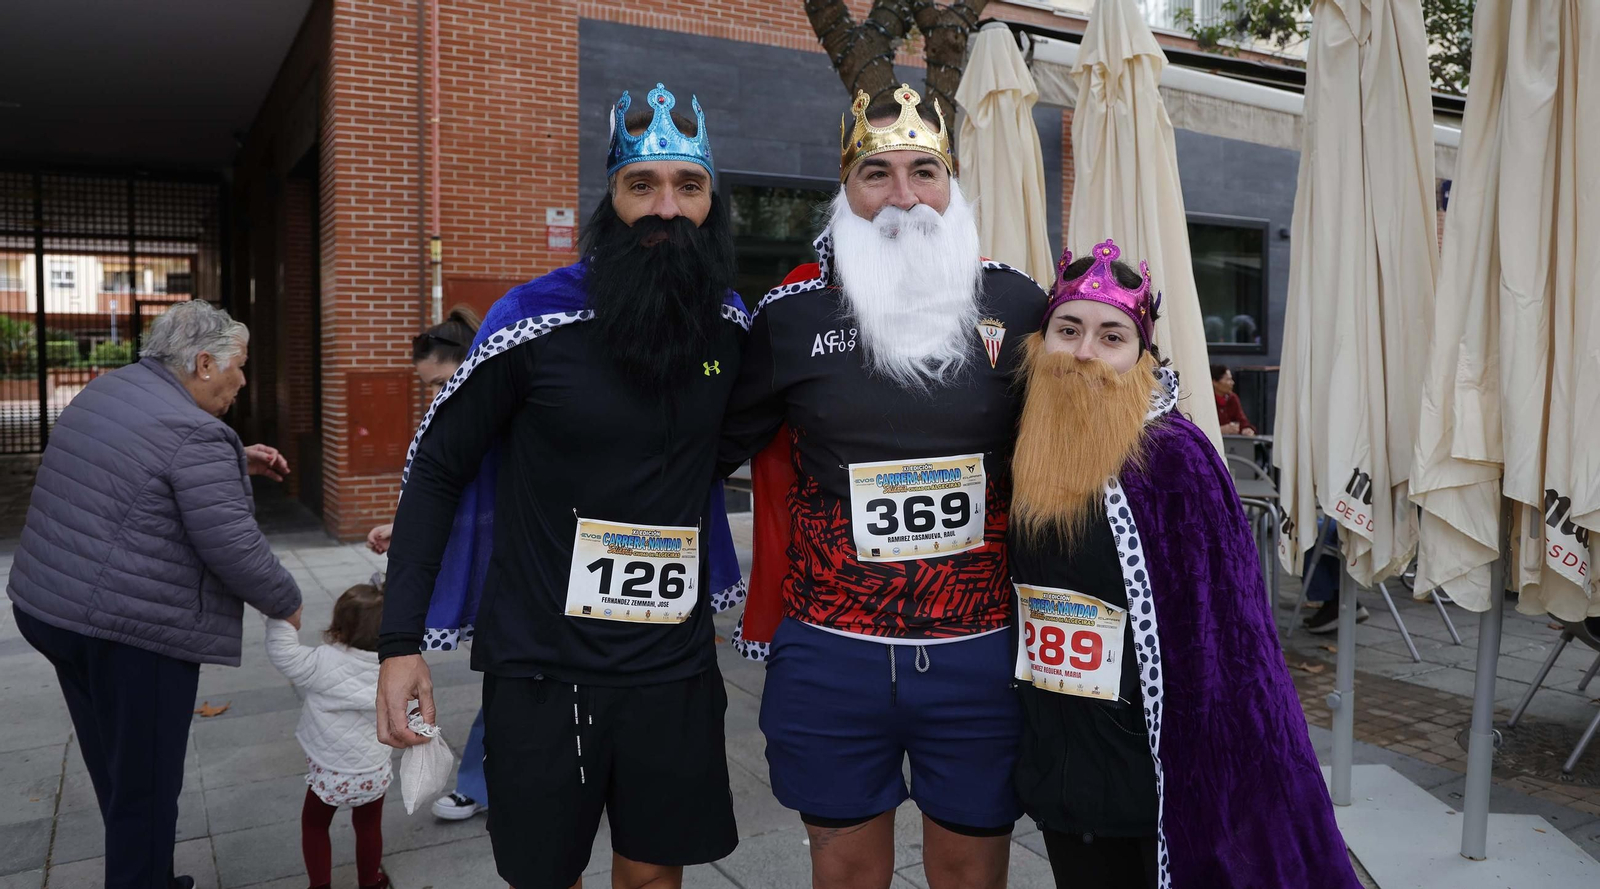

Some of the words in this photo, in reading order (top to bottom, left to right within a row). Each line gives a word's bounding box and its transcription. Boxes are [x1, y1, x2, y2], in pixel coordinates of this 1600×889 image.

[876, 472, 918, 487] CARRERA
[921, 468, 961, 484] NAVIDAD
[931, 482, 961, 490] ALGECIRAS
[866, 492, 971, 536] 369
[1335, 500, 1374, 532] DESD
[603, 532, 646, 550] CARRERA
[648, 537, 682, 551] NAVIDAD
[887, 535, 910, 543] RAMIREZ
[911, 532, 943, 541] CASANUEVA,
[586, 557, 686, 599] 126
[601, 597, 630, 605] FERNANDEZ
[1057, 602, 1098, 620] NAVIDAD
[1064, 617, 1095, 627] ALGECIRAS
[1025, 621, 1103, 671] 289
[1044, 666, 1064, 677] REQUENA,
[1064, 670, 1082, 679] MARIA
